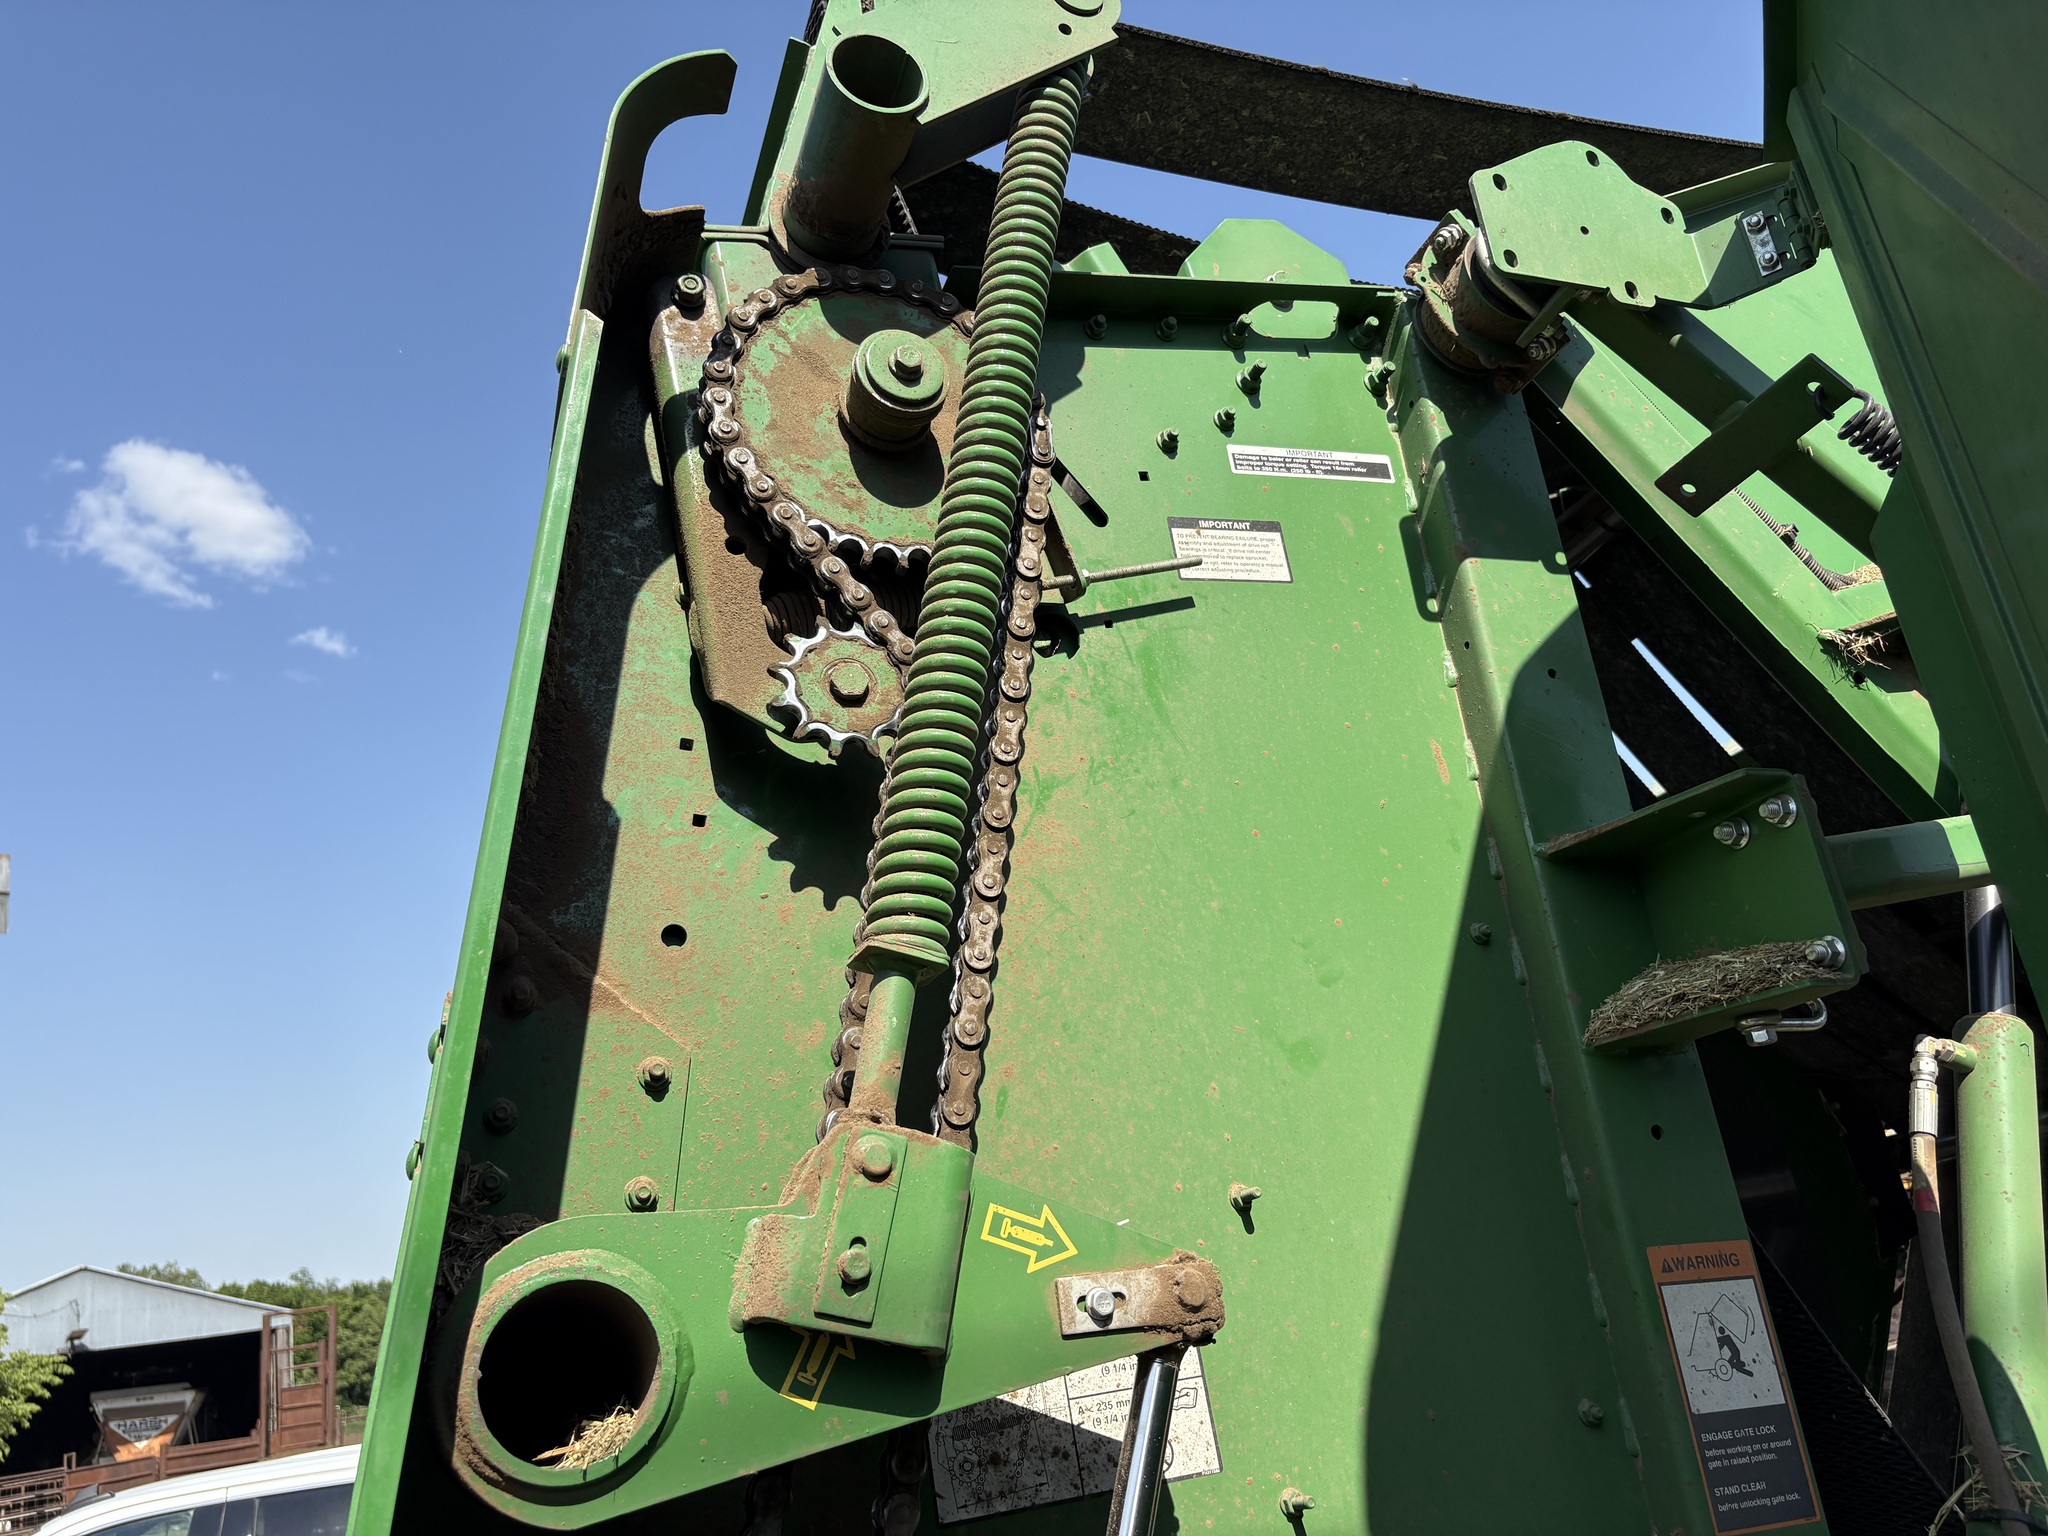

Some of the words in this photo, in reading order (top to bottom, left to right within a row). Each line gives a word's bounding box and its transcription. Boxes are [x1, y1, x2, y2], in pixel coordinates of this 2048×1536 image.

[1286, 450, 1333, 458] IMPORTANT
[1198, 520, 1250, 530] IMPORTANT
[1671, 1252, 1740, 1271] WARNING
[1101, 1365, 1110, 1377] (9
[1114, 1363, 1126, 1373] 1/4
[1078, 1406, 1085, 1415] A
[1096, 1400, 1113, 1412] 235
[1092, 1417, 1101, 1429] (9
[1105, 1414, 1118, 1424] 1/4
[1701, 1430, 1733, 1442] ENGAGE
[1734, 1428, 1755, 1438] GATE
[1755, 1425, 1776, 1436] LOCK
[1705, 1448, 1725, 1457] before
[1726, 1444, 1752, 1453] working
[1770, 1439, 1791, 1448] around
[1708, 1461, 1722, 1470] gate
[1730, 1455, 1750, 1465] raised
[1750, 1452, 1778, 1463] position.
[1714, 1485, 1740, 1497] STAND
[1741, 1481, 1766, 1492] CLEAR
[1718, 1502, 1738, 1512] before
[1740, 1498, 1771, 1507] unlocking
[1772, 1495, 1785, 1505] gate
[1786, 1492, 1801, 1500] lock.
